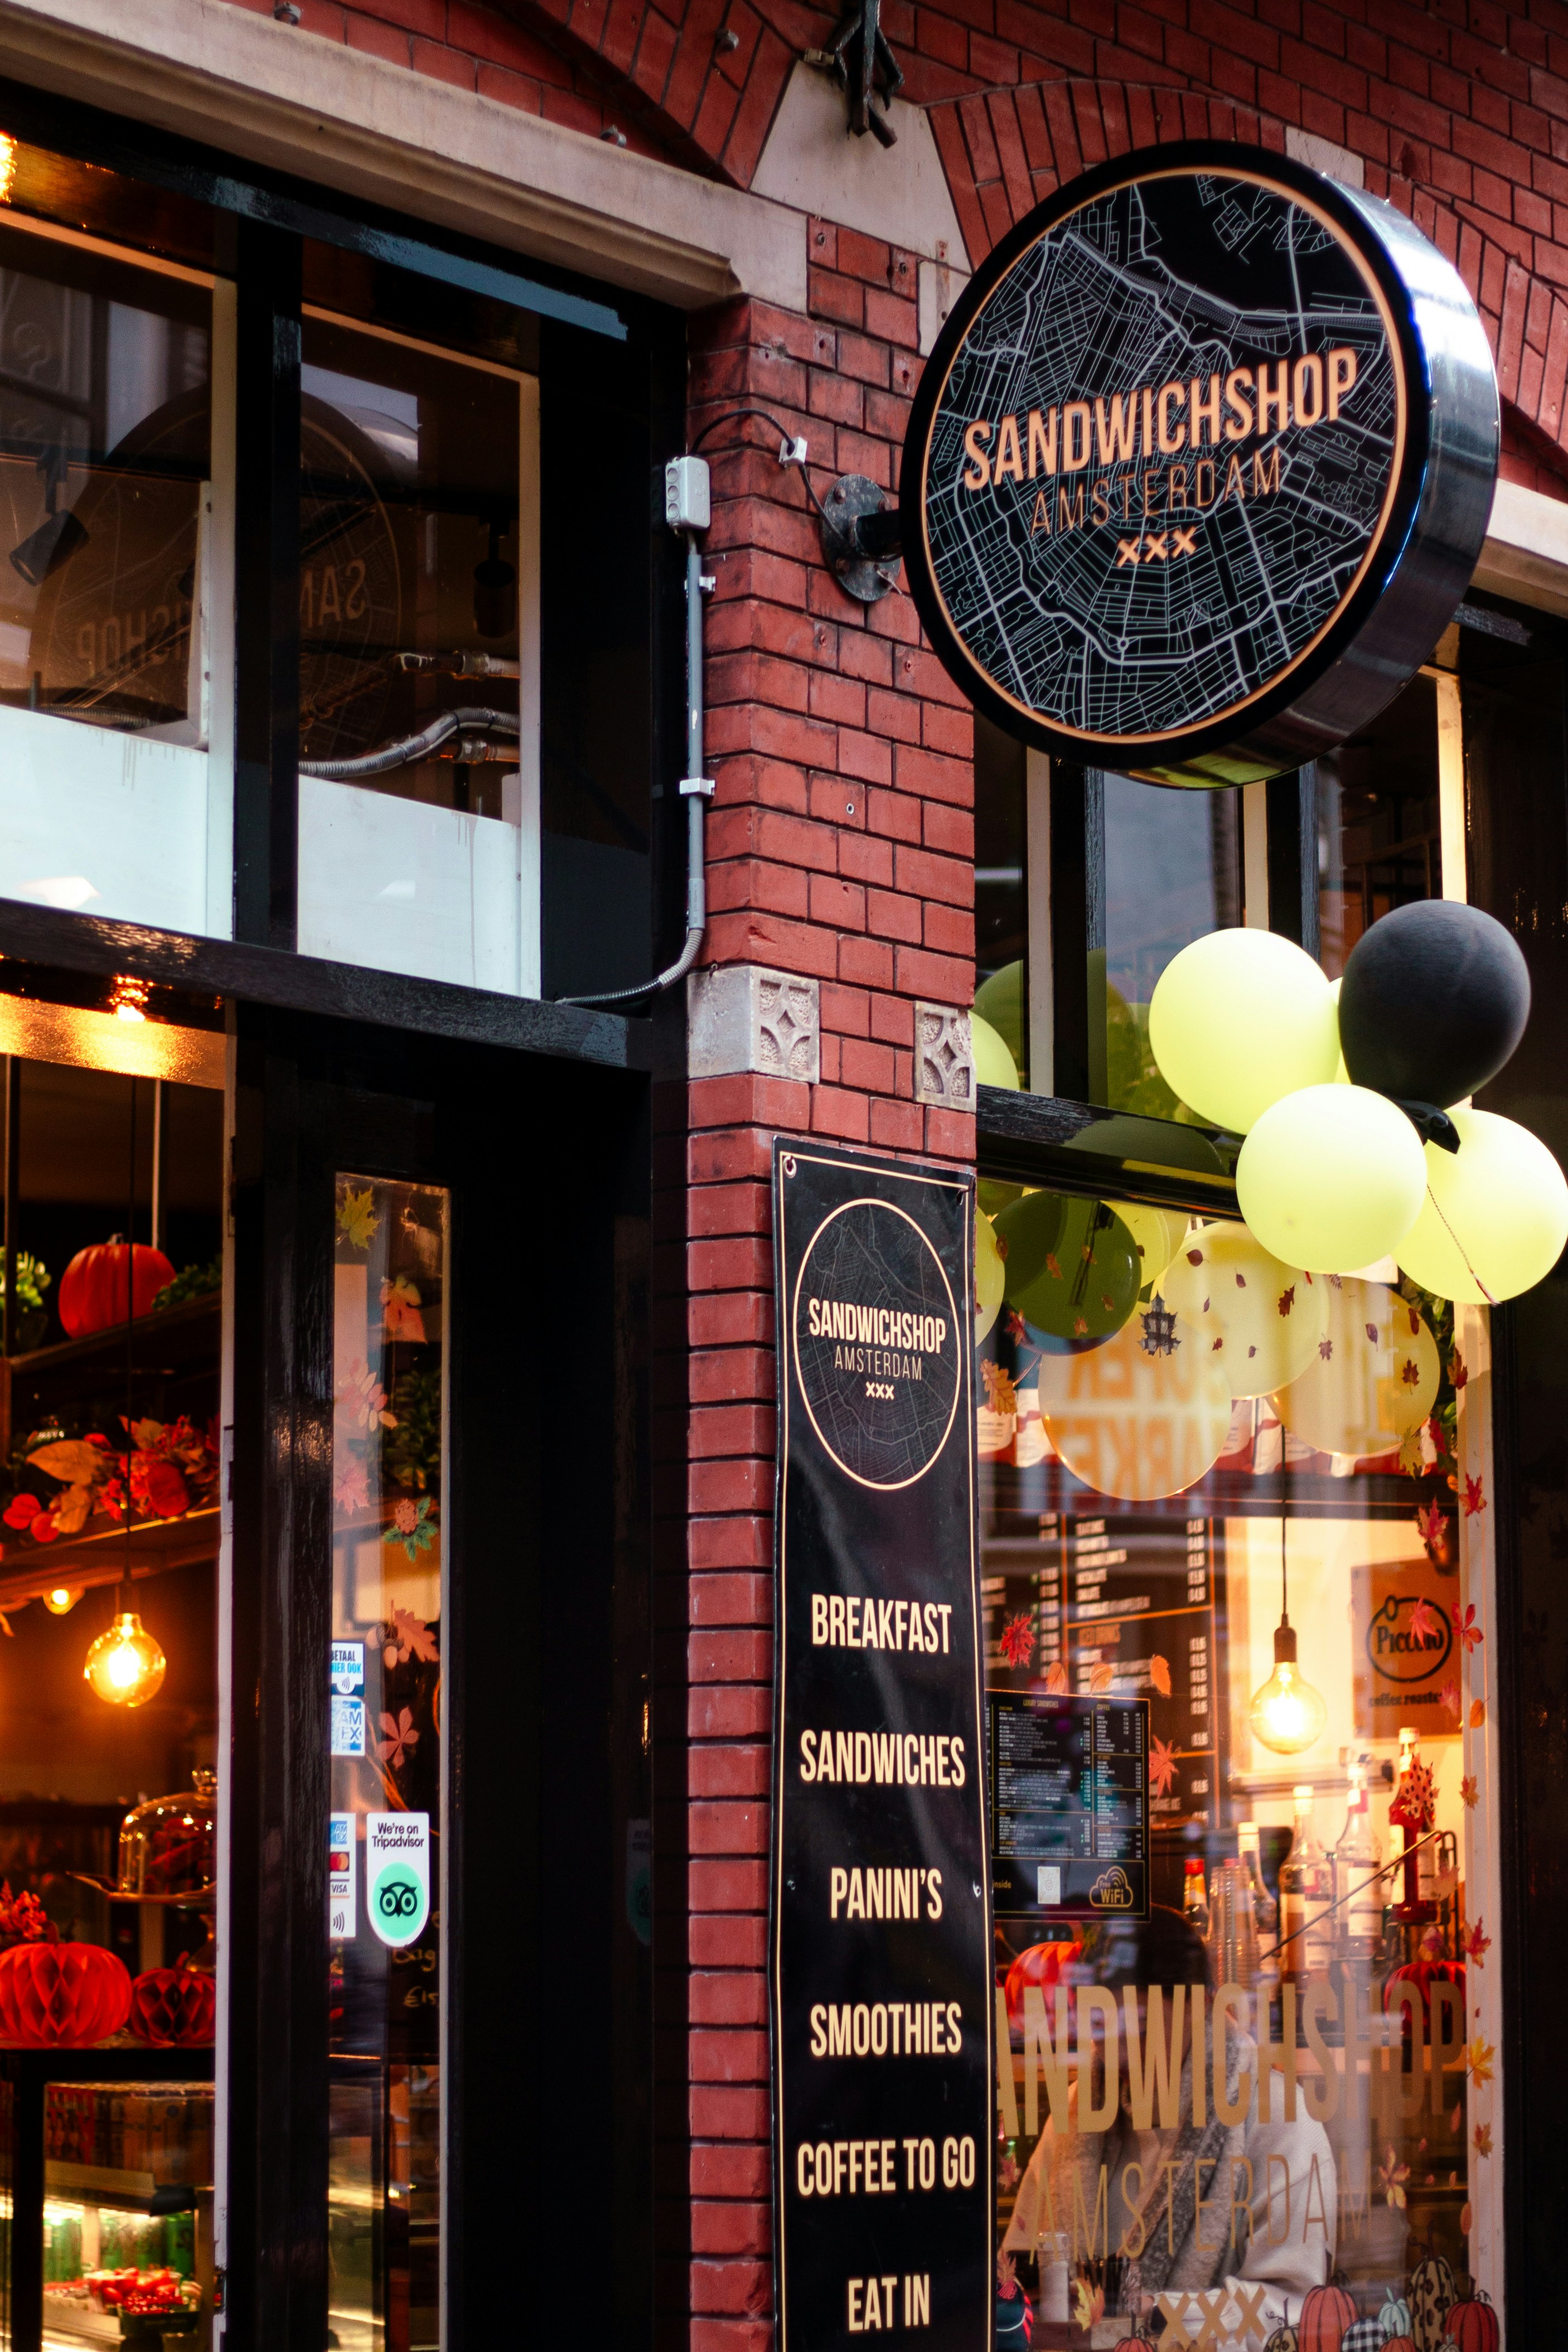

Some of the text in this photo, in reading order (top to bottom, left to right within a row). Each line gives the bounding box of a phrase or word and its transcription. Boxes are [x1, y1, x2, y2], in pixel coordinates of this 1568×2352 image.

[962, 347, 1358, 490] SANDWICHSHOP
[1030, 446, 1282, 536] AMSTERDAM
[809, 1298, 946, 1354] SANDWICHSHOP
[835, 1345, 922, 1381] AMSTERDAM
[811, 1594, 952, 1654] BREAKFAST
[347, 1663, 361, 1674] OOK
[800, 1729, 966, 1787] SANDWICHES
[372, 1836, 424, 1850] Tripadvisor
[407, 1825, 418, 1835] on
[332, 1884, 347, 1894] VISA
[831, 1867, 942, 1920] PANINI'S
[1100, 1889, 1124, 1904] WiFi
[810, 2002, 962, 2058] SMOOTHIES
[996, 1981, 1464, 2137] ANDWICHSHOP
[797, 2135, 975, 2197] COFFEE TO GO
[1029, 2143, 1373, 2266] AMSTERDAM
[848, 2274, 930, 2332] EAT IN
